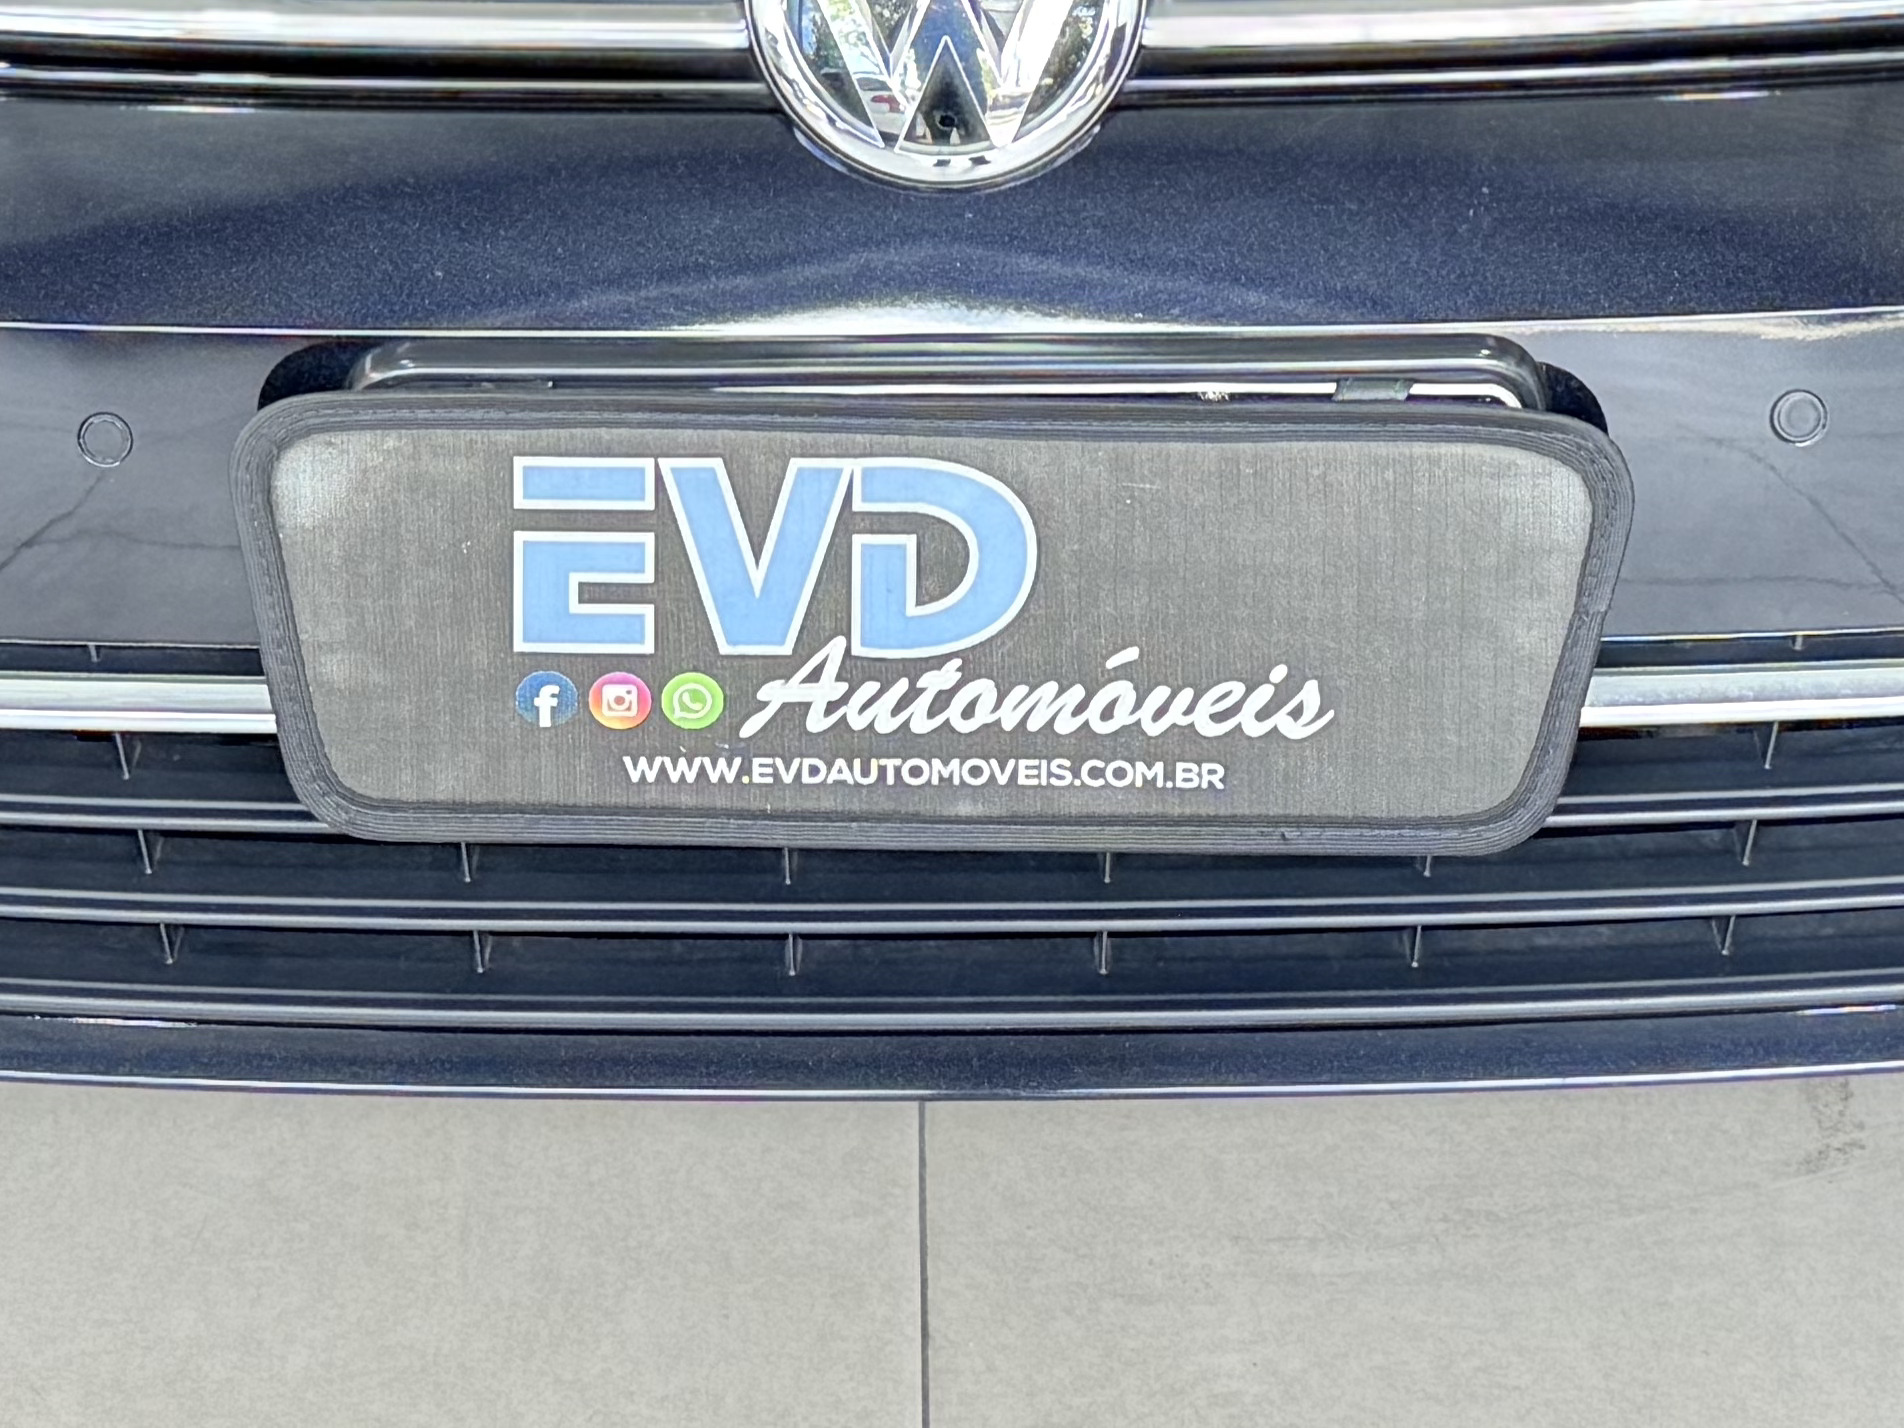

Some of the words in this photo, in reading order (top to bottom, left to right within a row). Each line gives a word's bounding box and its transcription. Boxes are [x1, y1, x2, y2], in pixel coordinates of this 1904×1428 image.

[513, 455, 1038, 659] EVD
[739, 635, 1335, 740] Automóveis
[622, 755, 1226, 791] WWW.EVDAUTOMOVEIS.COM.BR
